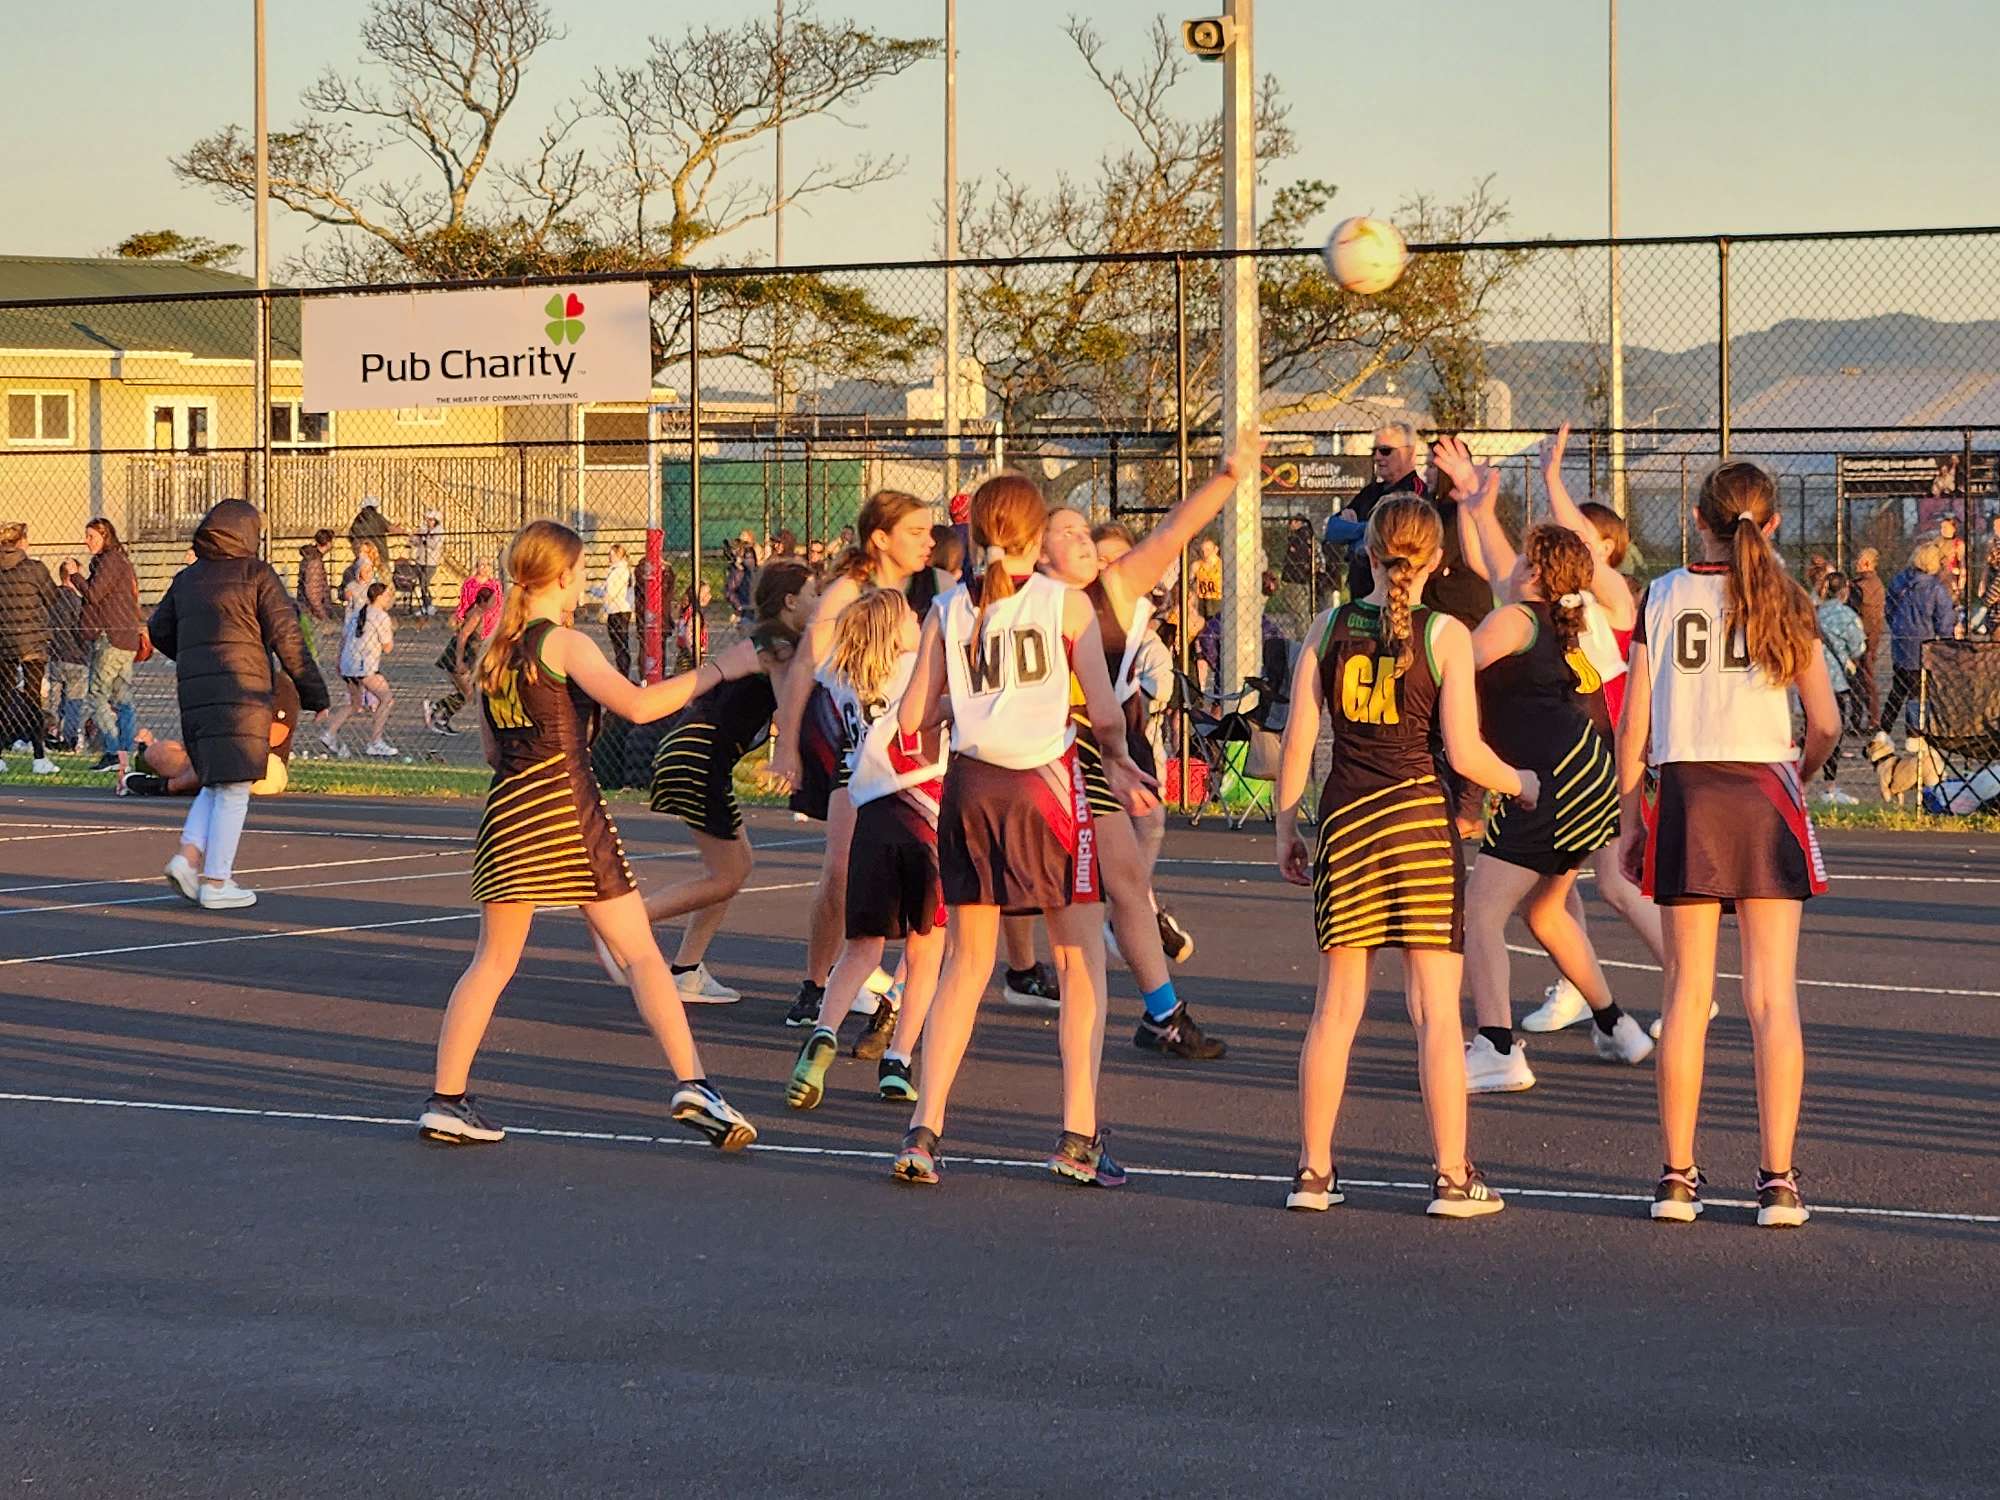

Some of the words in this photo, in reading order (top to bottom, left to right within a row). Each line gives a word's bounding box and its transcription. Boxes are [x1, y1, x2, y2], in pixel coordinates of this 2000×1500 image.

[361, 352, 430, 383] Pub
[440, 346, 576, 383] Charity
[492, 394, 541, 402] COMMUNITY
[543, 392, 579, 400] FUNDING
[1299, 462, 1341, 476] Infinity
[1299, 475, 1366, 488] Foundation
[957, 624, 1053, 698] WD
[1341, 654, 1400, 725] GA
